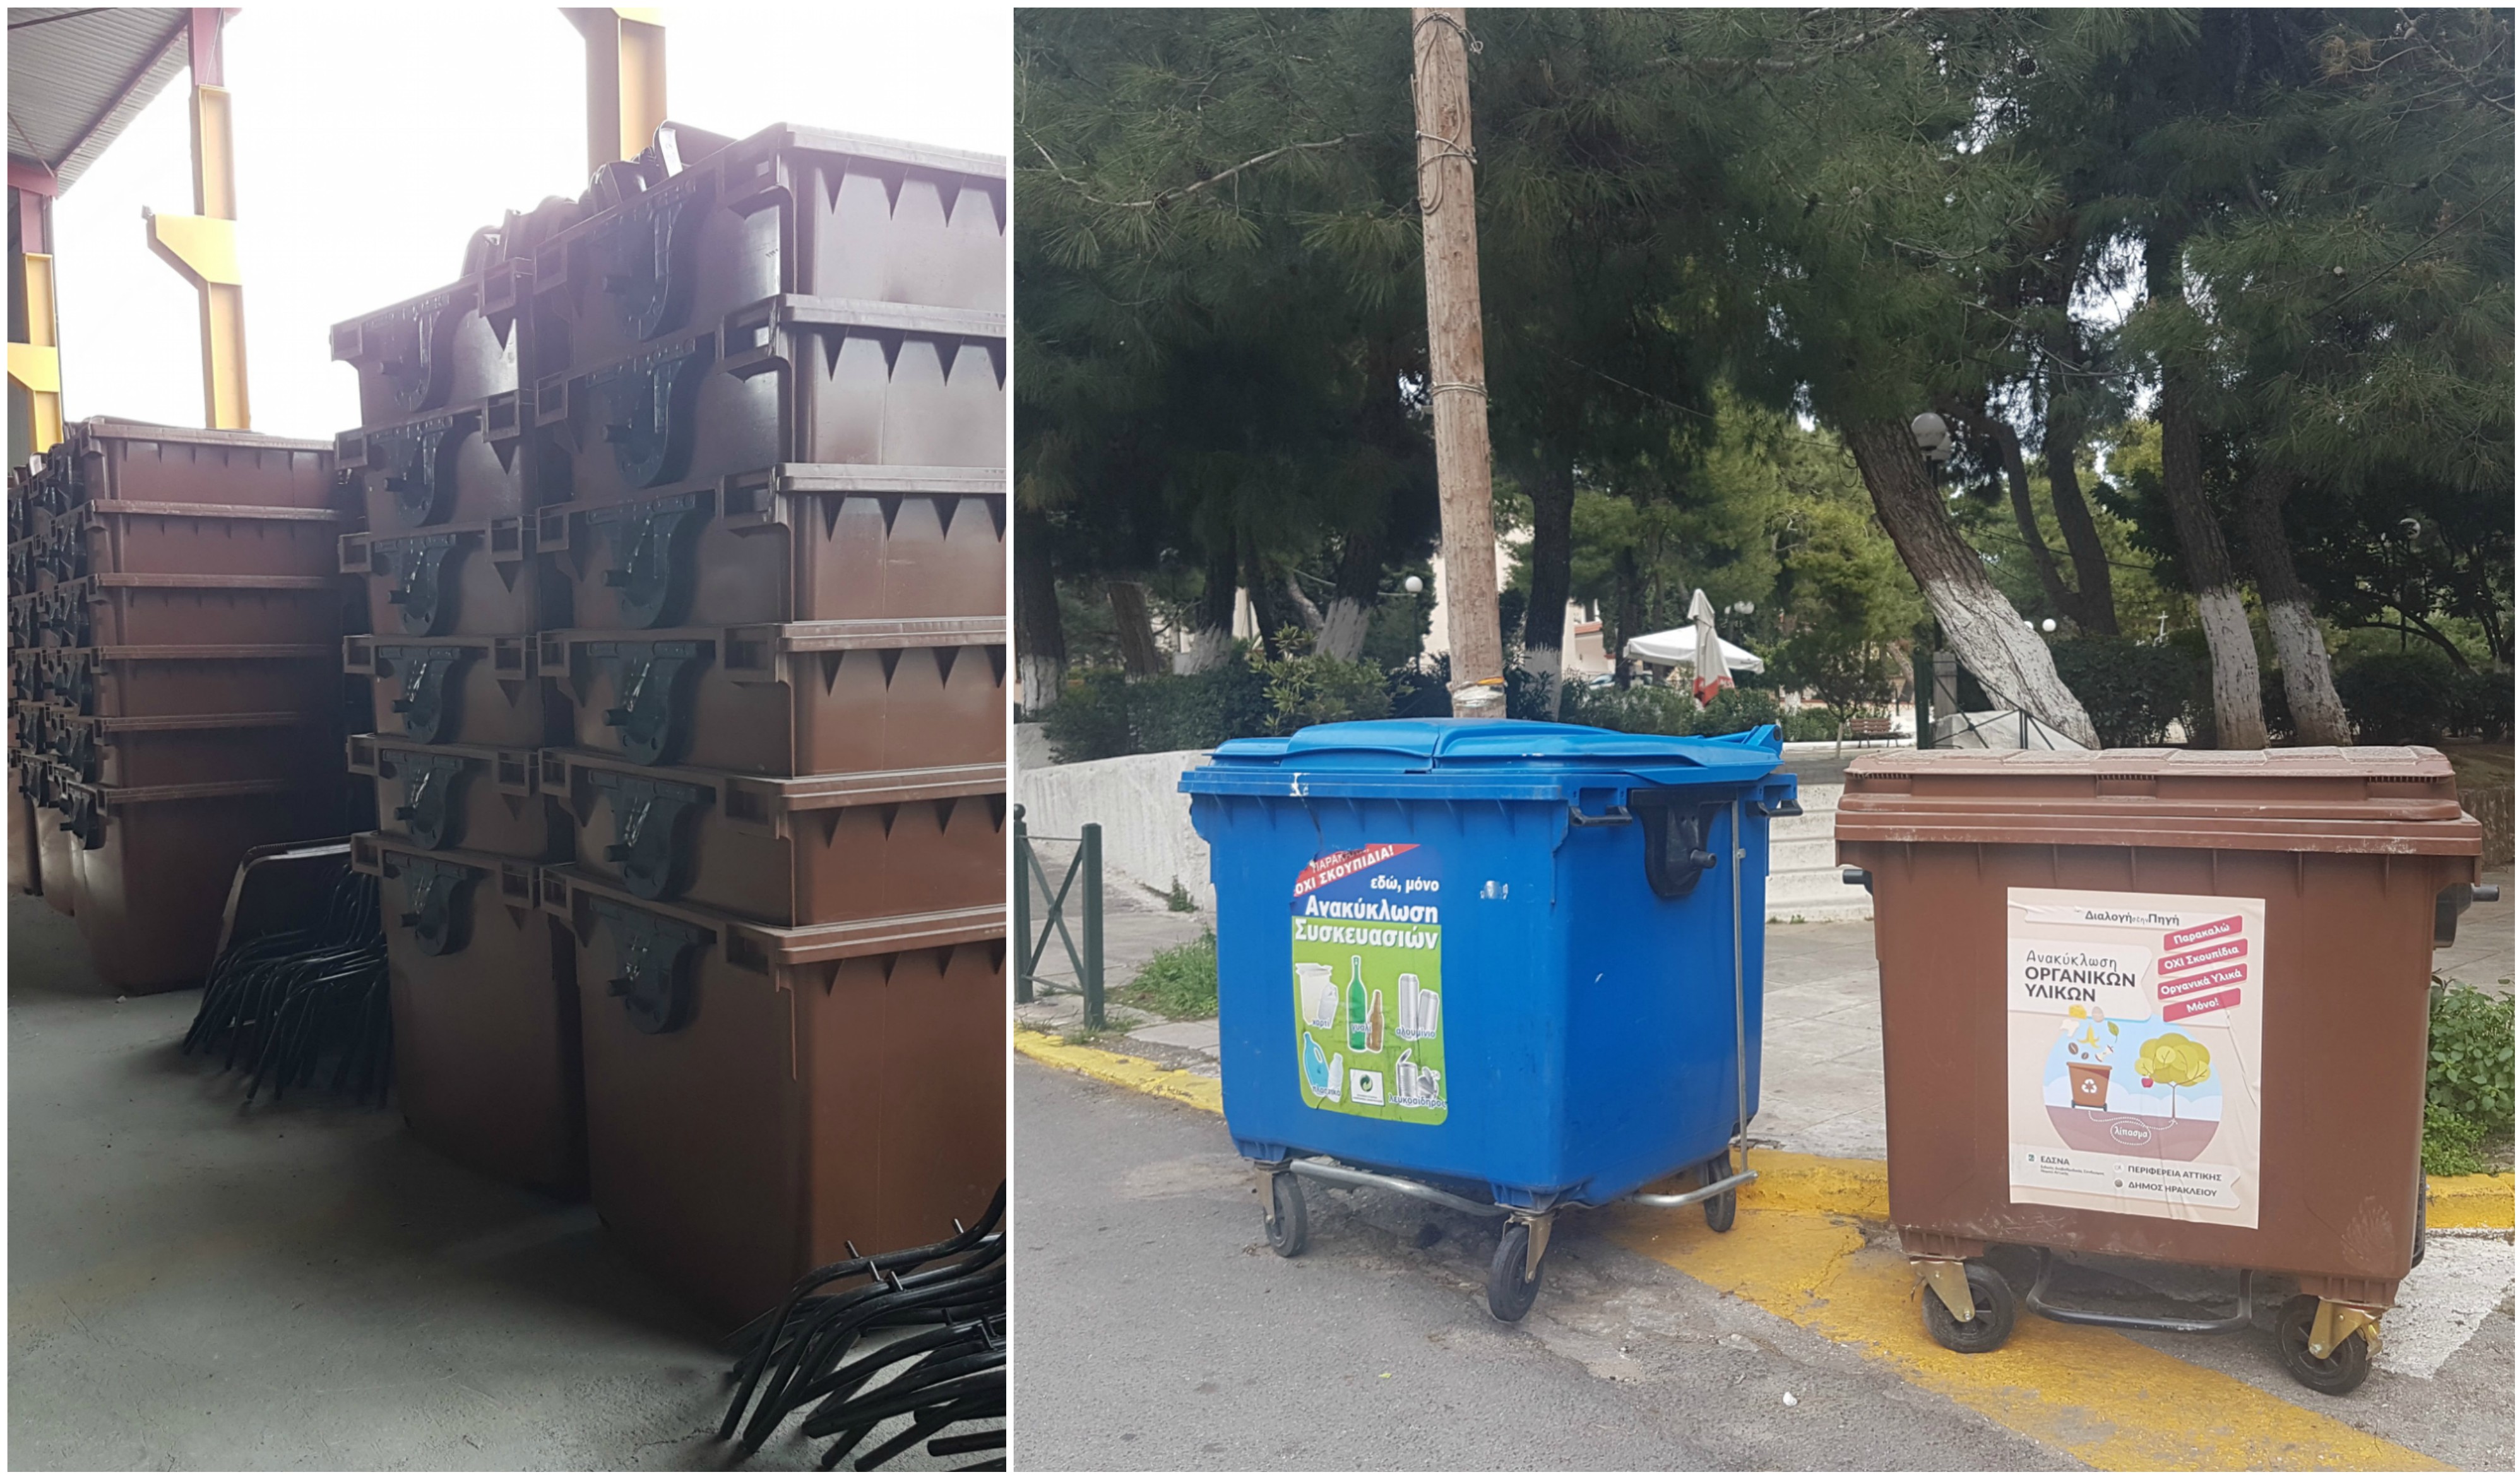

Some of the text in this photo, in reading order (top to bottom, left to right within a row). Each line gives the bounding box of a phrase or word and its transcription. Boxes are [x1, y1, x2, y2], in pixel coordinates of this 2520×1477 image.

[1295, 845, 1394, 895] ΟΧΙ ΣΚΟΥΠΙΔΙΑ!
[1370, 875, 1440, 894] εδώ, μόνο
[1305, 895, 1439, 923] Ανακύκλωση
[2085, 910, 2132, 923] Διαλογή
[2148, 913, 2180, 926] Πηγή
[1295, 918, 1439, 950] Συσκευασιών
[2173, 923, 2230, 944] Παρακαλώ
[2026, 949, 2117, 973] Ανακύκλωση
[2164, 946, 2240, 970] ΟΧΙ Σκουπίδια
[2025, 966, 2135, 987] ΟΡΓΑΝΙΚΩΝ
[2160, 969, 2243, 995] Οργανικά Υλικά
[2025, 983, 2096, 1002] ΥΛΙΚΩΝ
[2186, 997, 2220, 1013] Μόνο!
[2115, 1126, 2148, 1140] λίπασμα
[2040, 1156, 2070, 1165] ΕΔΣΝΑ
[2128, 1165, 2181, 1178] ΠΕΡΙΦΕΡΕΙΑ
[2182, 1172, 2222, 1182] ΑΤΤΙΚΗΣ
[2128, 1182, 2218, 1197] ΔΗΜΟΣ ΗΡΑΚΛΕΙΟΥ
